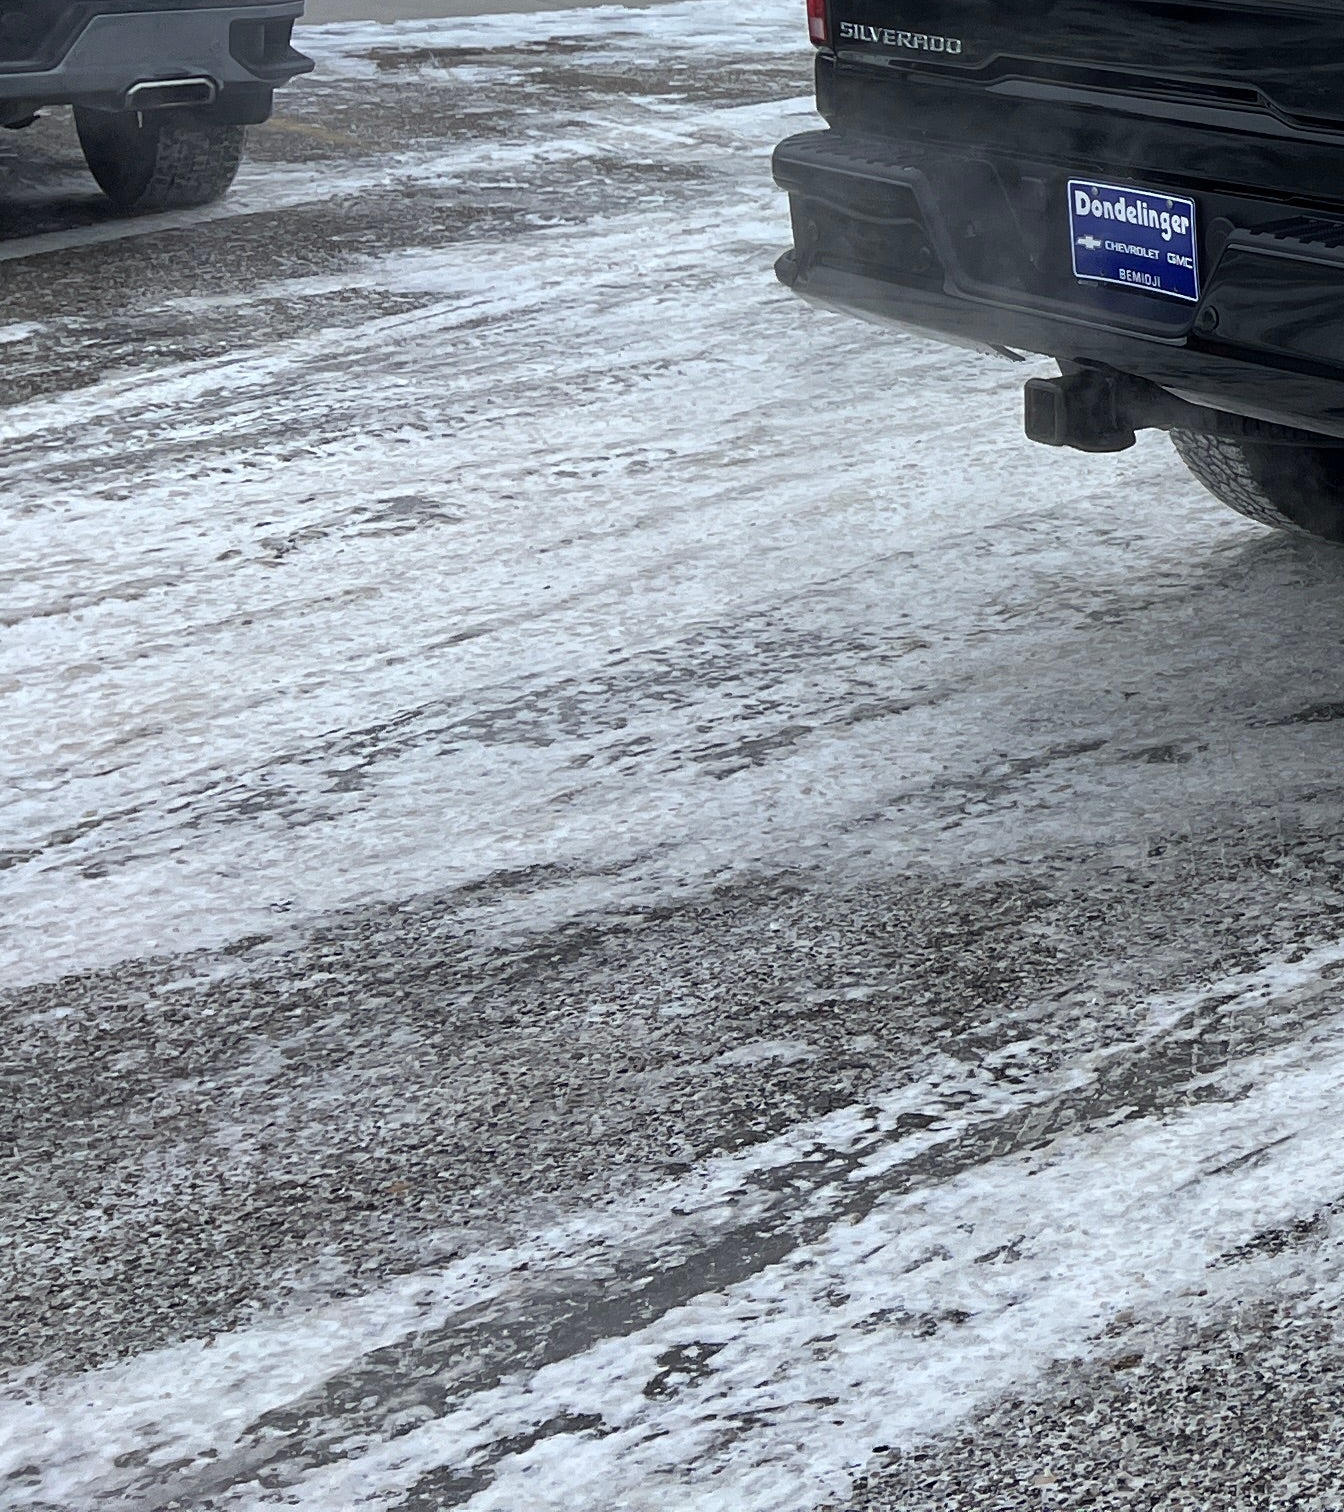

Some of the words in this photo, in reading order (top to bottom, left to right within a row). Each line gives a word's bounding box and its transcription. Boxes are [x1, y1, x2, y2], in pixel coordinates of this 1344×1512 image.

[840, 21, 962, 54] SILVERADO
[1074, 190, 1190, 241] Dondelinger
[1104, 240, 1160, 260] CHEVROLET
[1167, 252, 1193, 269] GMC
[1118, 268, 1161, 288] BEMIDJI
